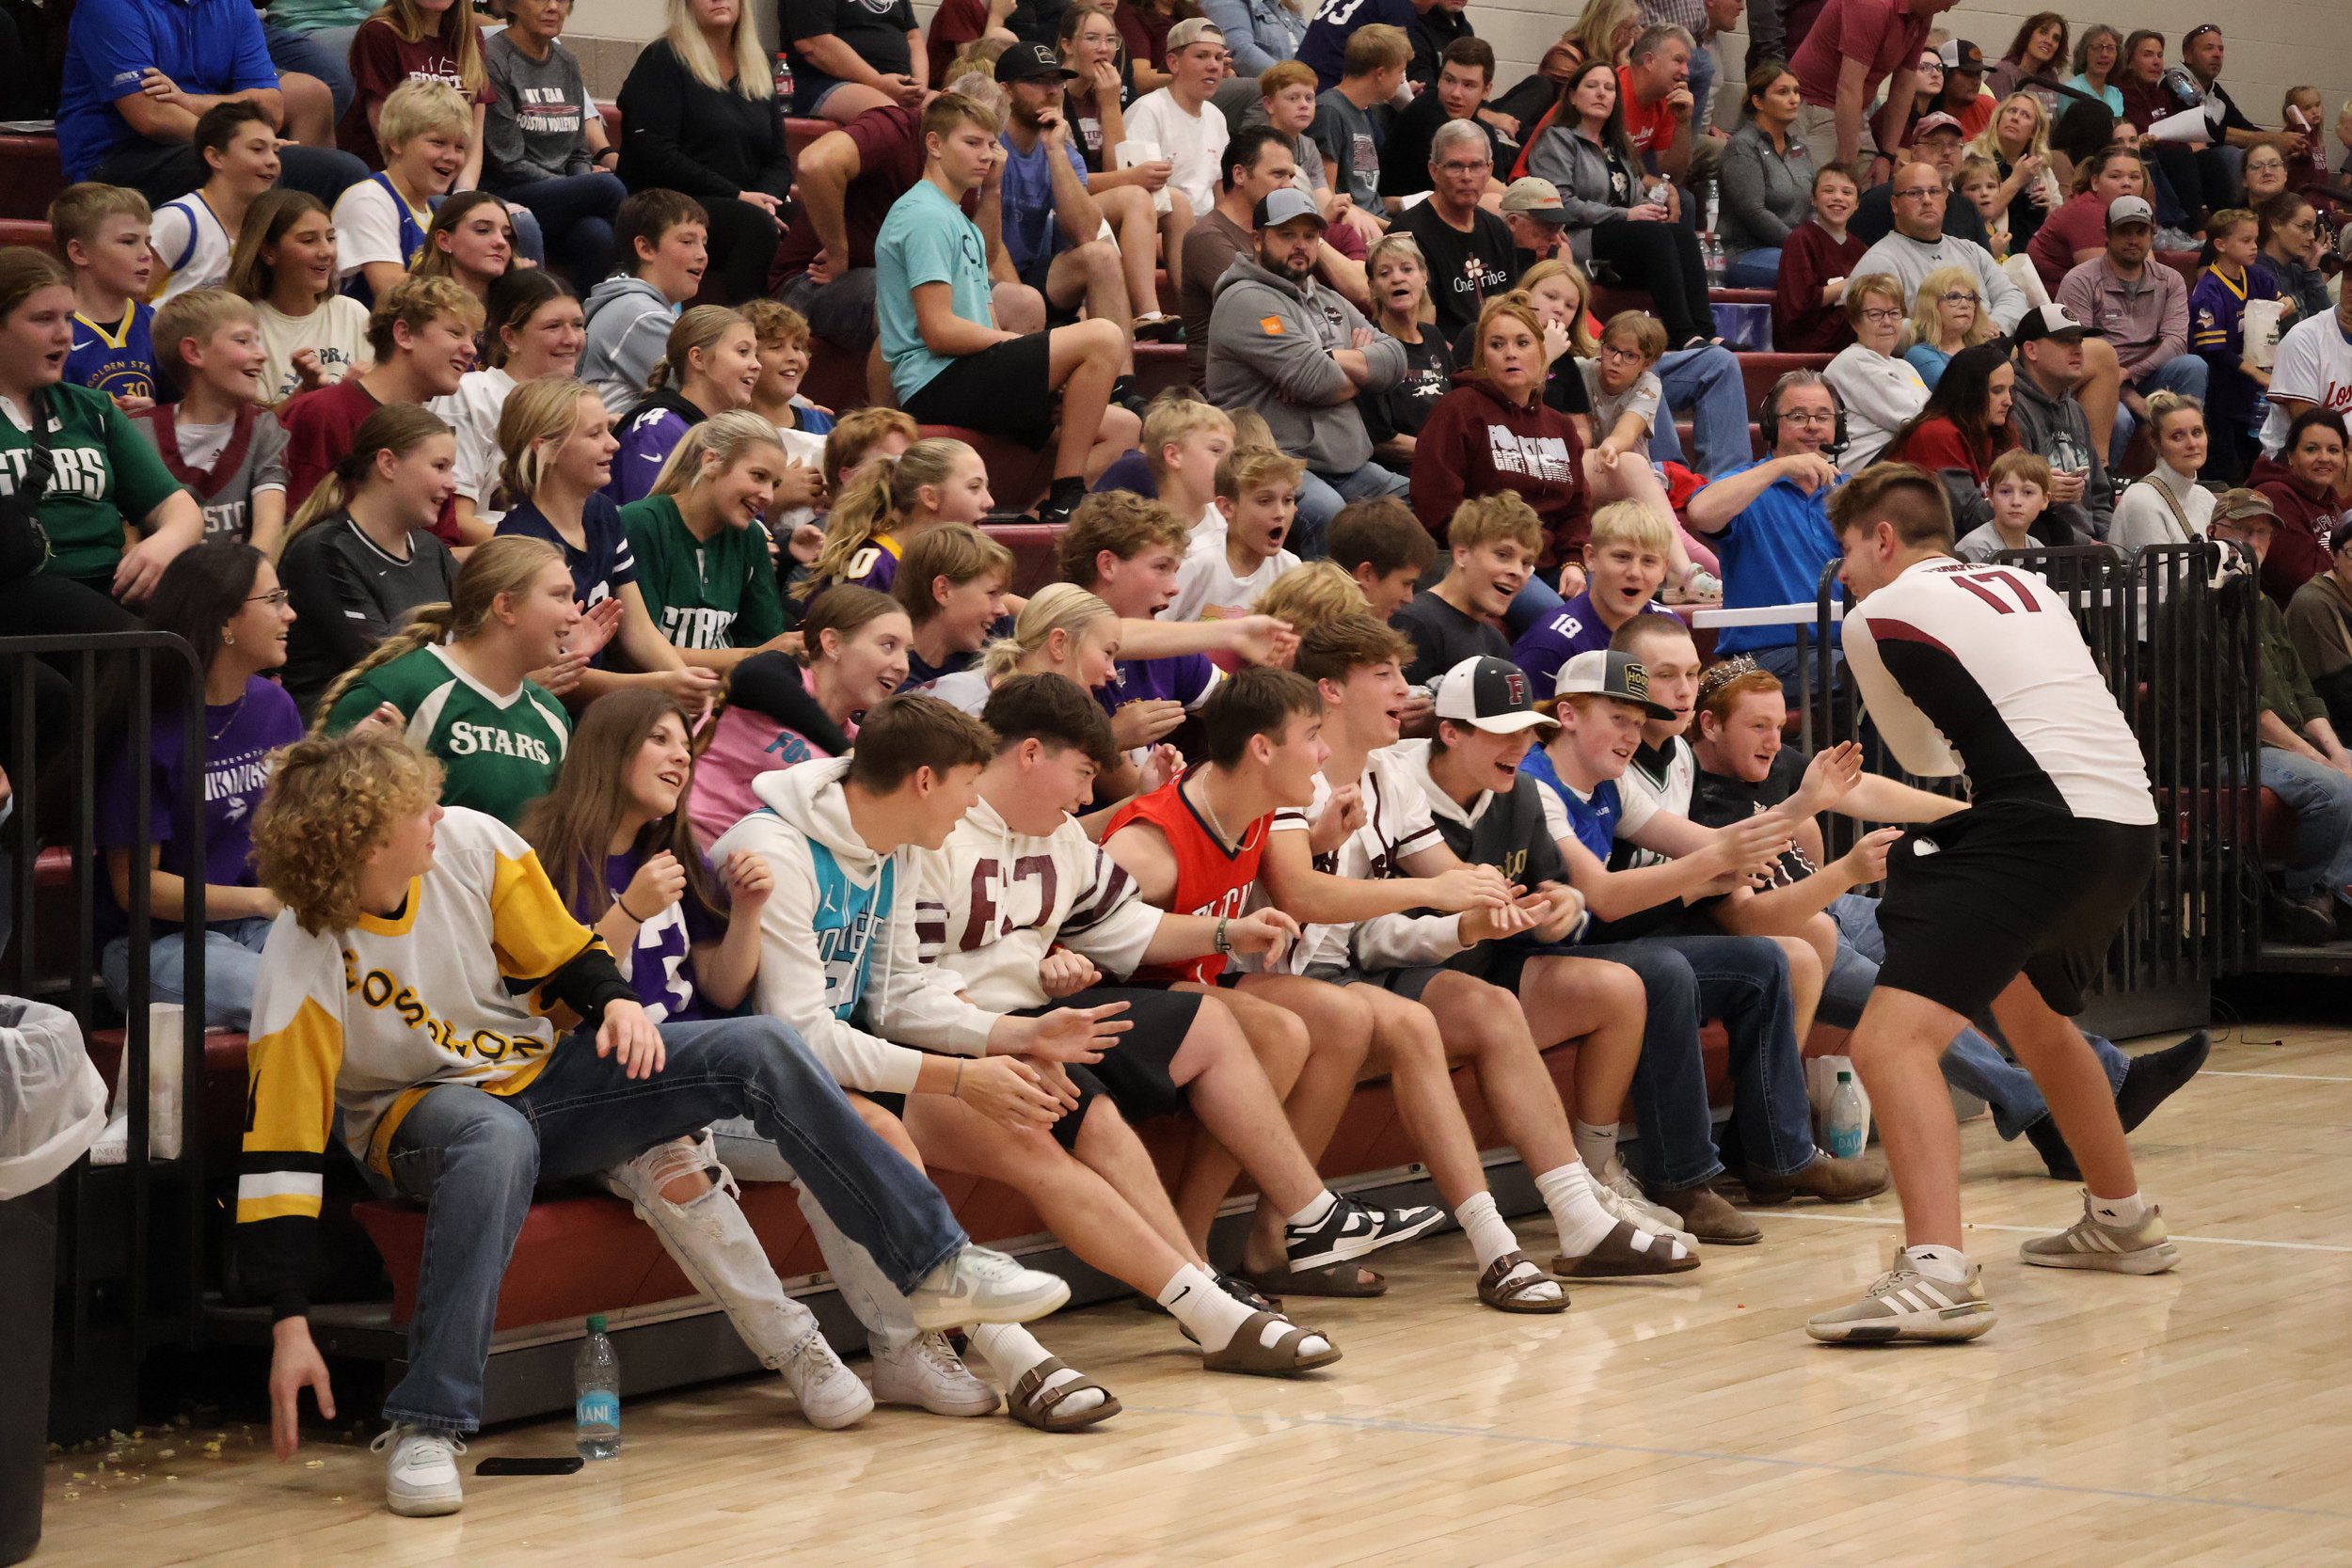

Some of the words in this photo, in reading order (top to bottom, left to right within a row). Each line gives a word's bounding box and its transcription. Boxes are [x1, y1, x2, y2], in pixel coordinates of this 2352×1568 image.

[87, 360, 126, 388] GOLDEN
[122, 381, 150, 398] 30
[632, 407, 669, 433] 14
[1949, 570, 2042, 615] 17
[1549, 613, 1583, 640] 18
[1505, 674, 1524, 705] F
[449, 721, 551, 766] STARS
